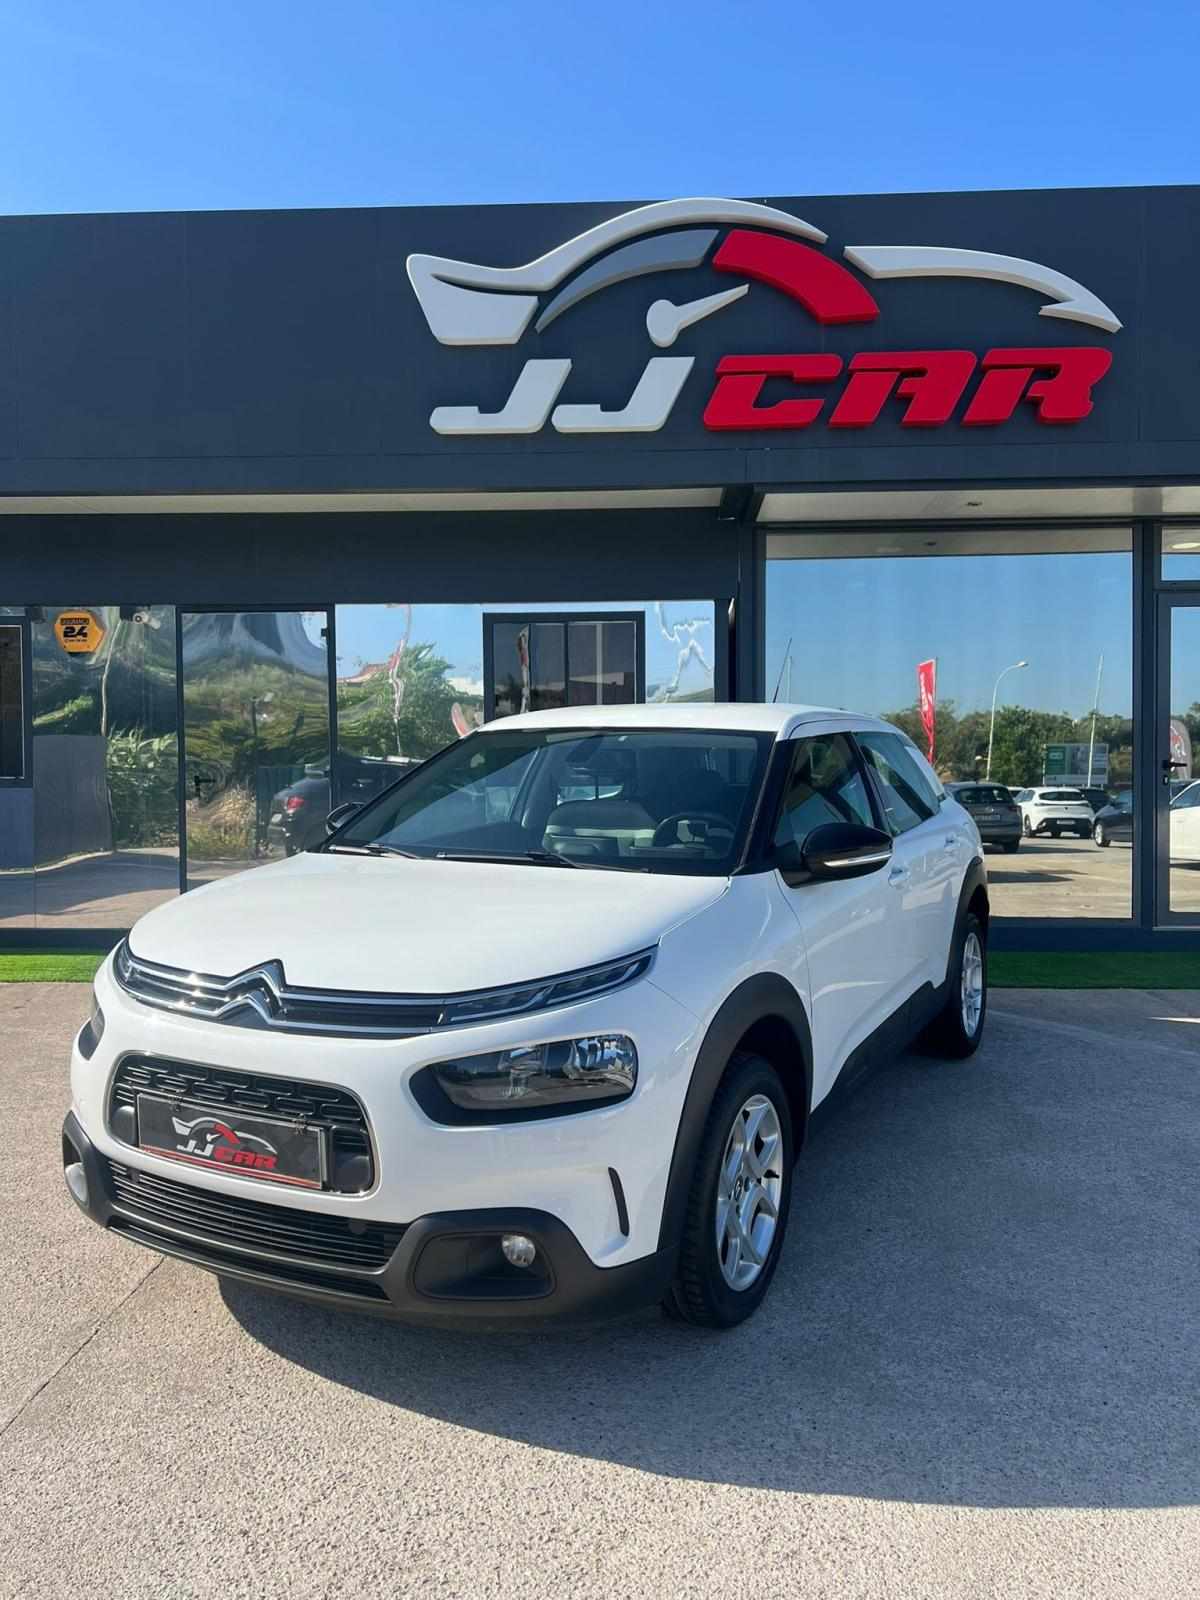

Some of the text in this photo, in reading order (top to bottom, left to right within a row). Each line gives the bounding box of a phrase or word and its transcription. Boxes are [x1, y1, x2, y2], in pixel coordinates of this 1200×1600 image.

[429, 346, 1112, 435] JJ CAR
[63, 626, 88, 638] 24
[213, 1147, 277, 1169] CAR
